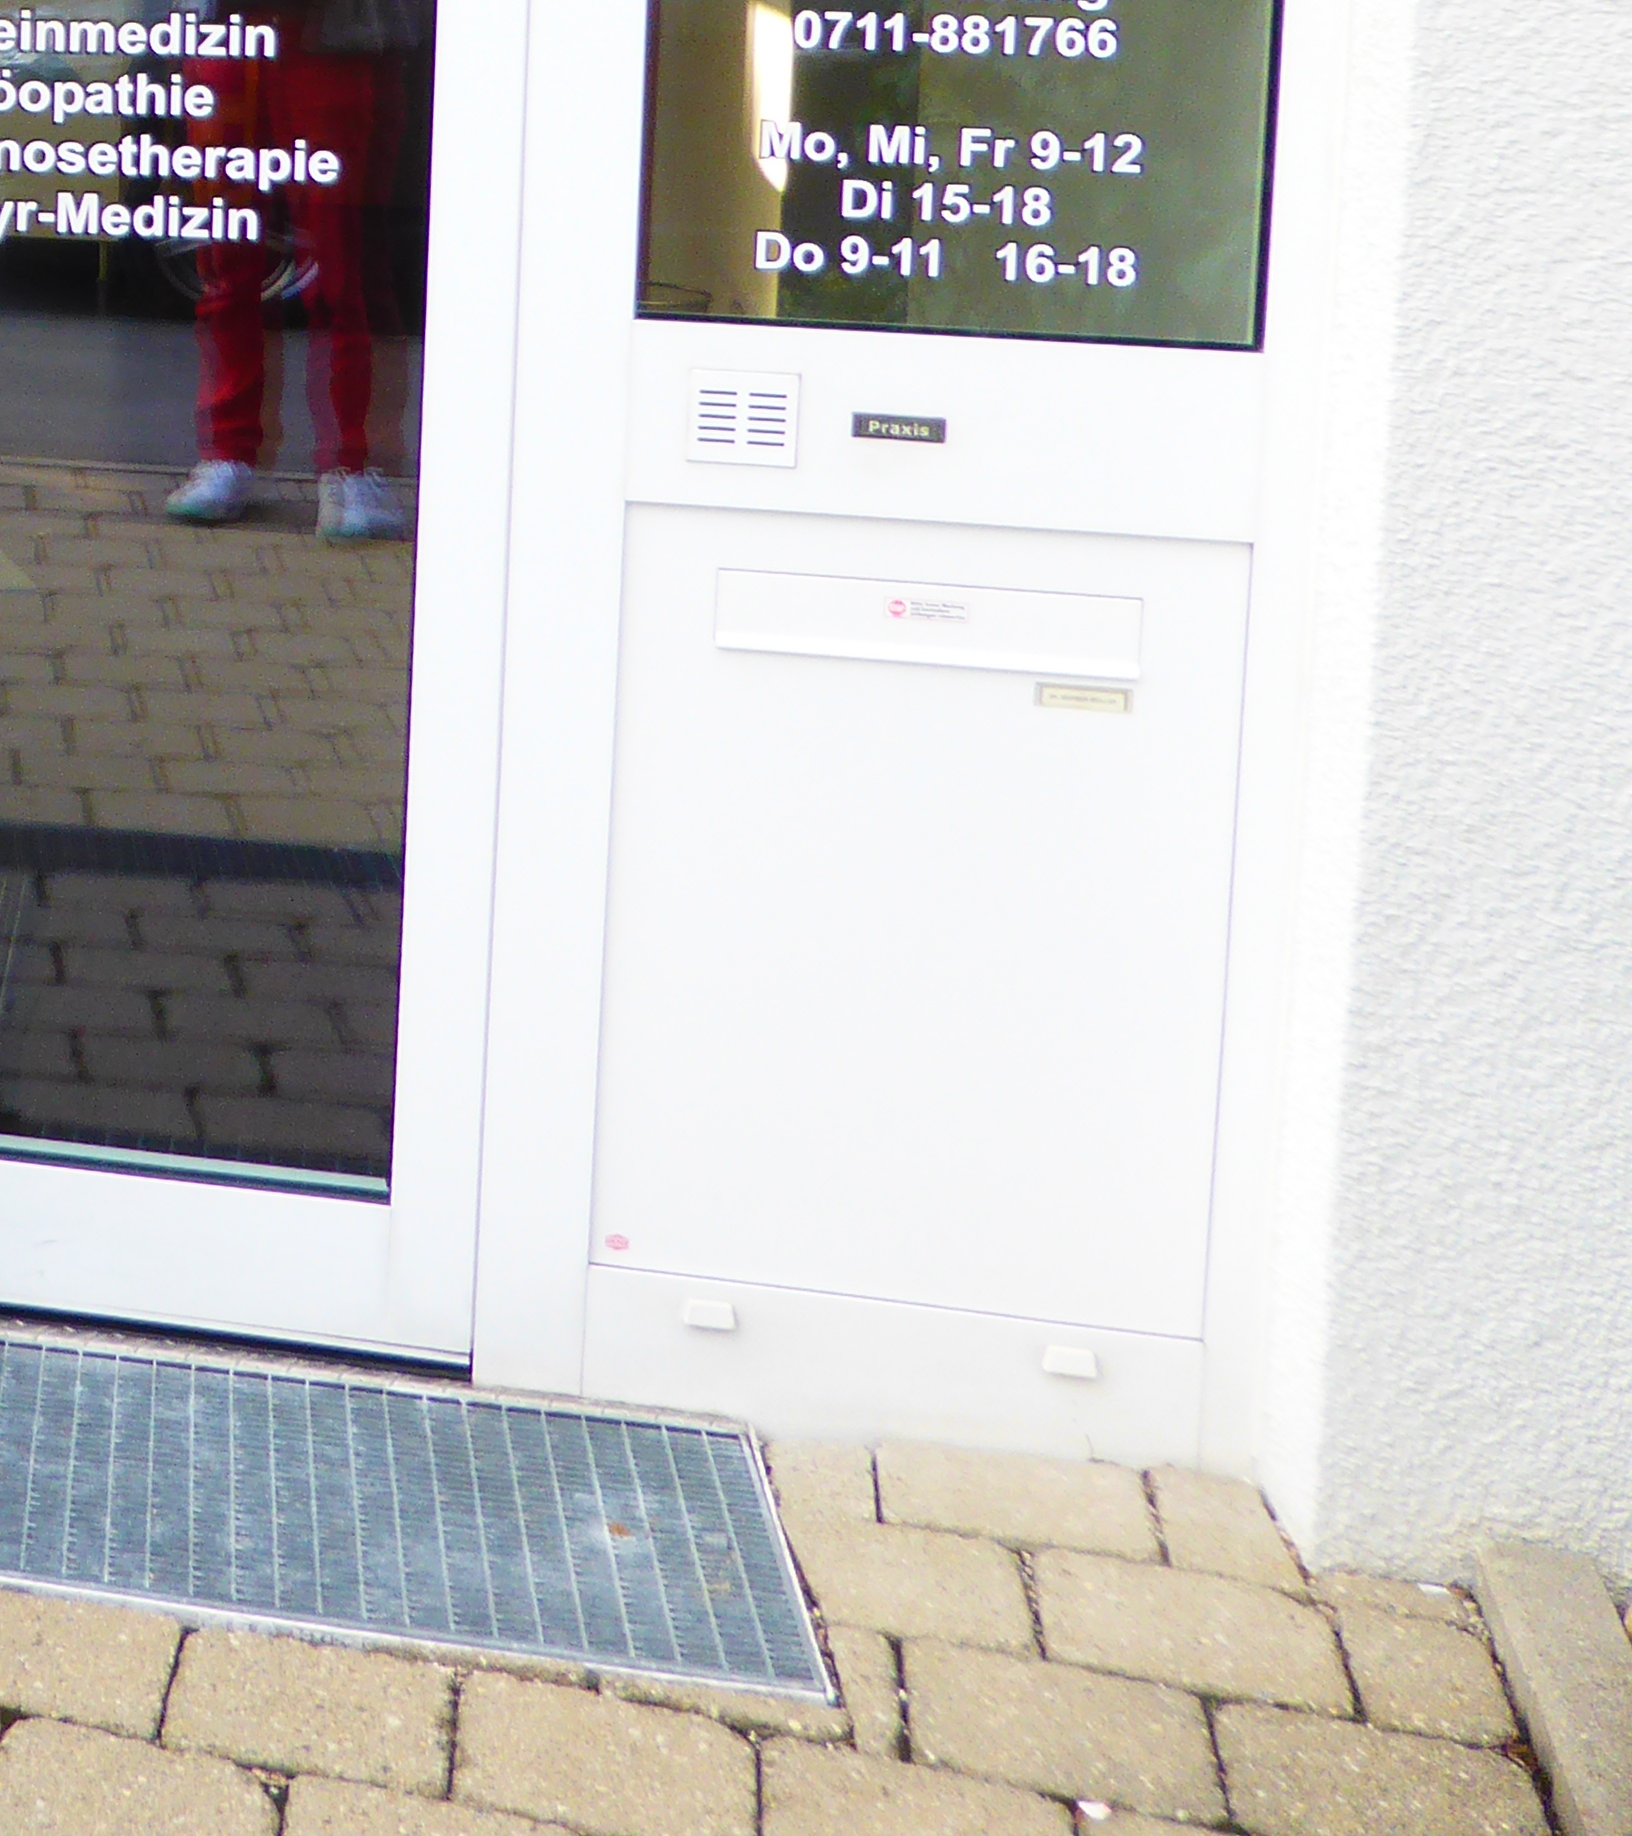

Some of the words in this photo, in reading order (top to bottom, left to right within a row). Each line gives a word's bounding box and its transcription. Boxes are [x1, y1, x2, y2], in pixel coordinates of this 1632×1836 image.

[792, 10, 1120, 59] 0711-881766
[758, 119, 849, 169] Mo,
[867, 123, 941, 174] Mi,
[959, 126, 1017, 169] Fr
[1029, 130, 1143, 175] 9-12
[840, 178, 894, 221] Di
[911, 181, 1052, 228] 15-18
[754, 230, 826, 273] Do
[839, 234, 941, 279] 9-11
[995, 241, 1137, 288] 16-18
[867, 419, 931, 437] Praxis
